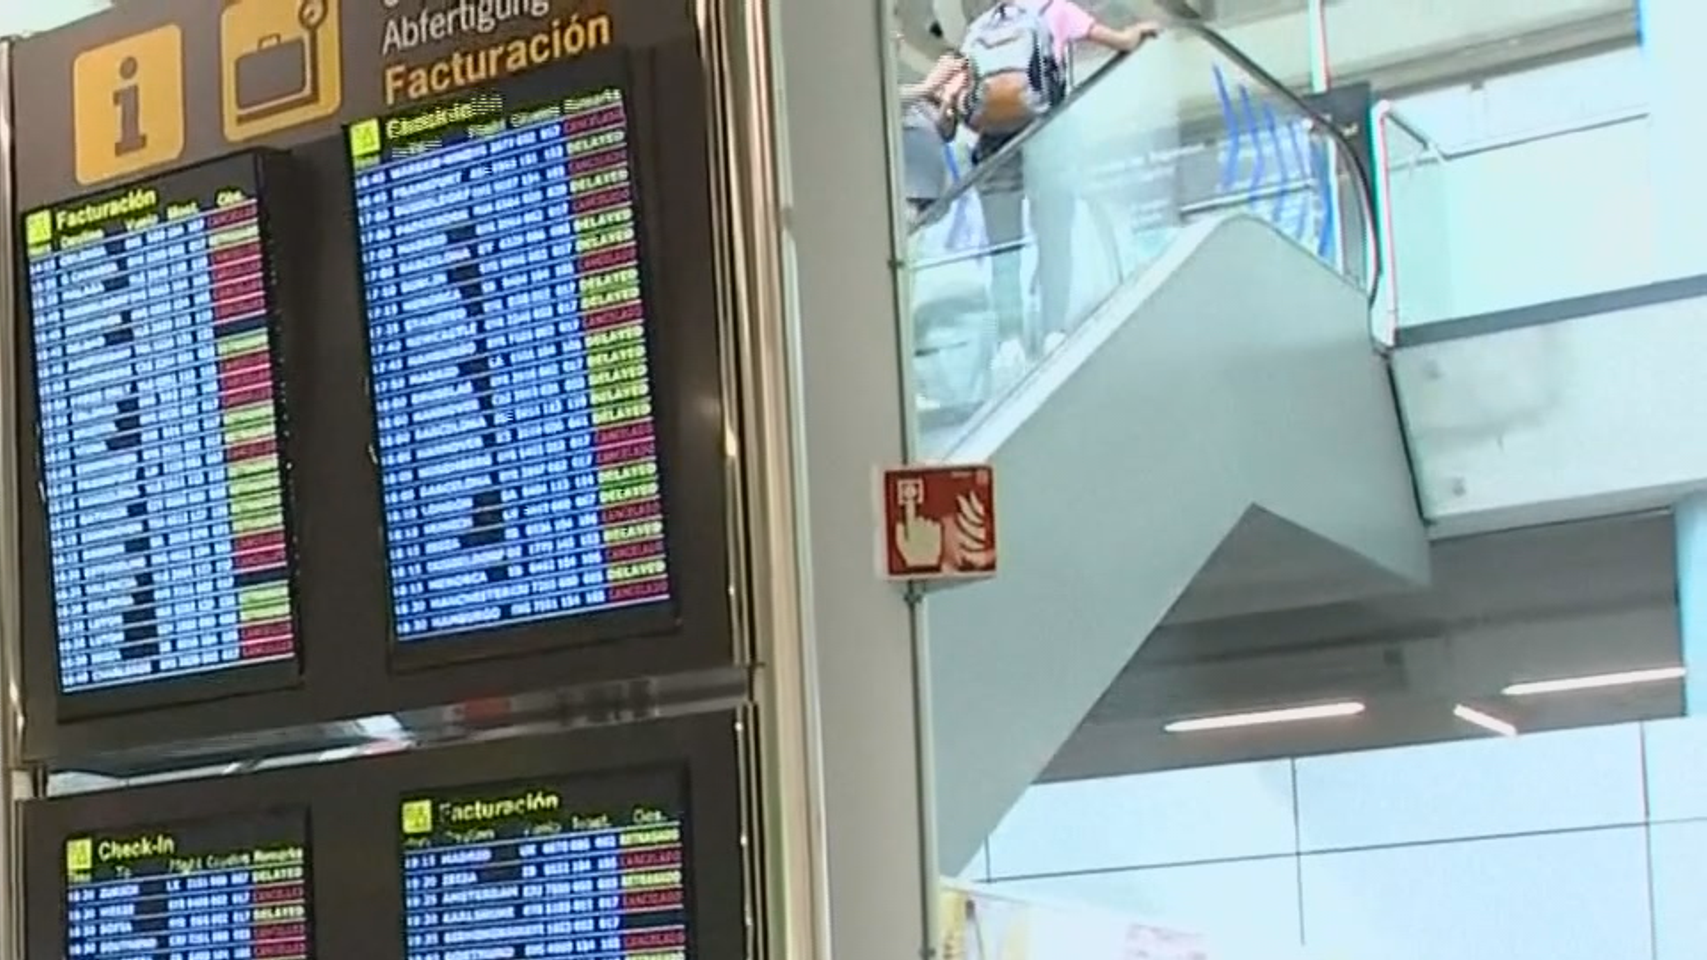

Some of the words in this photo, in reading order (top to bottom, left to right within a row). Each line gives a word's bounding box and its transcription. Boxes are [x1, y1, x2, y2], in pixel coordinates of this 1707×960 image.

[382, 0, 550, 54] Abfertigung
[383, 13, 613, 105] Facturación
[55, 189, 156, 230] Facturación
[439, 791, 558, 823] Facturación
